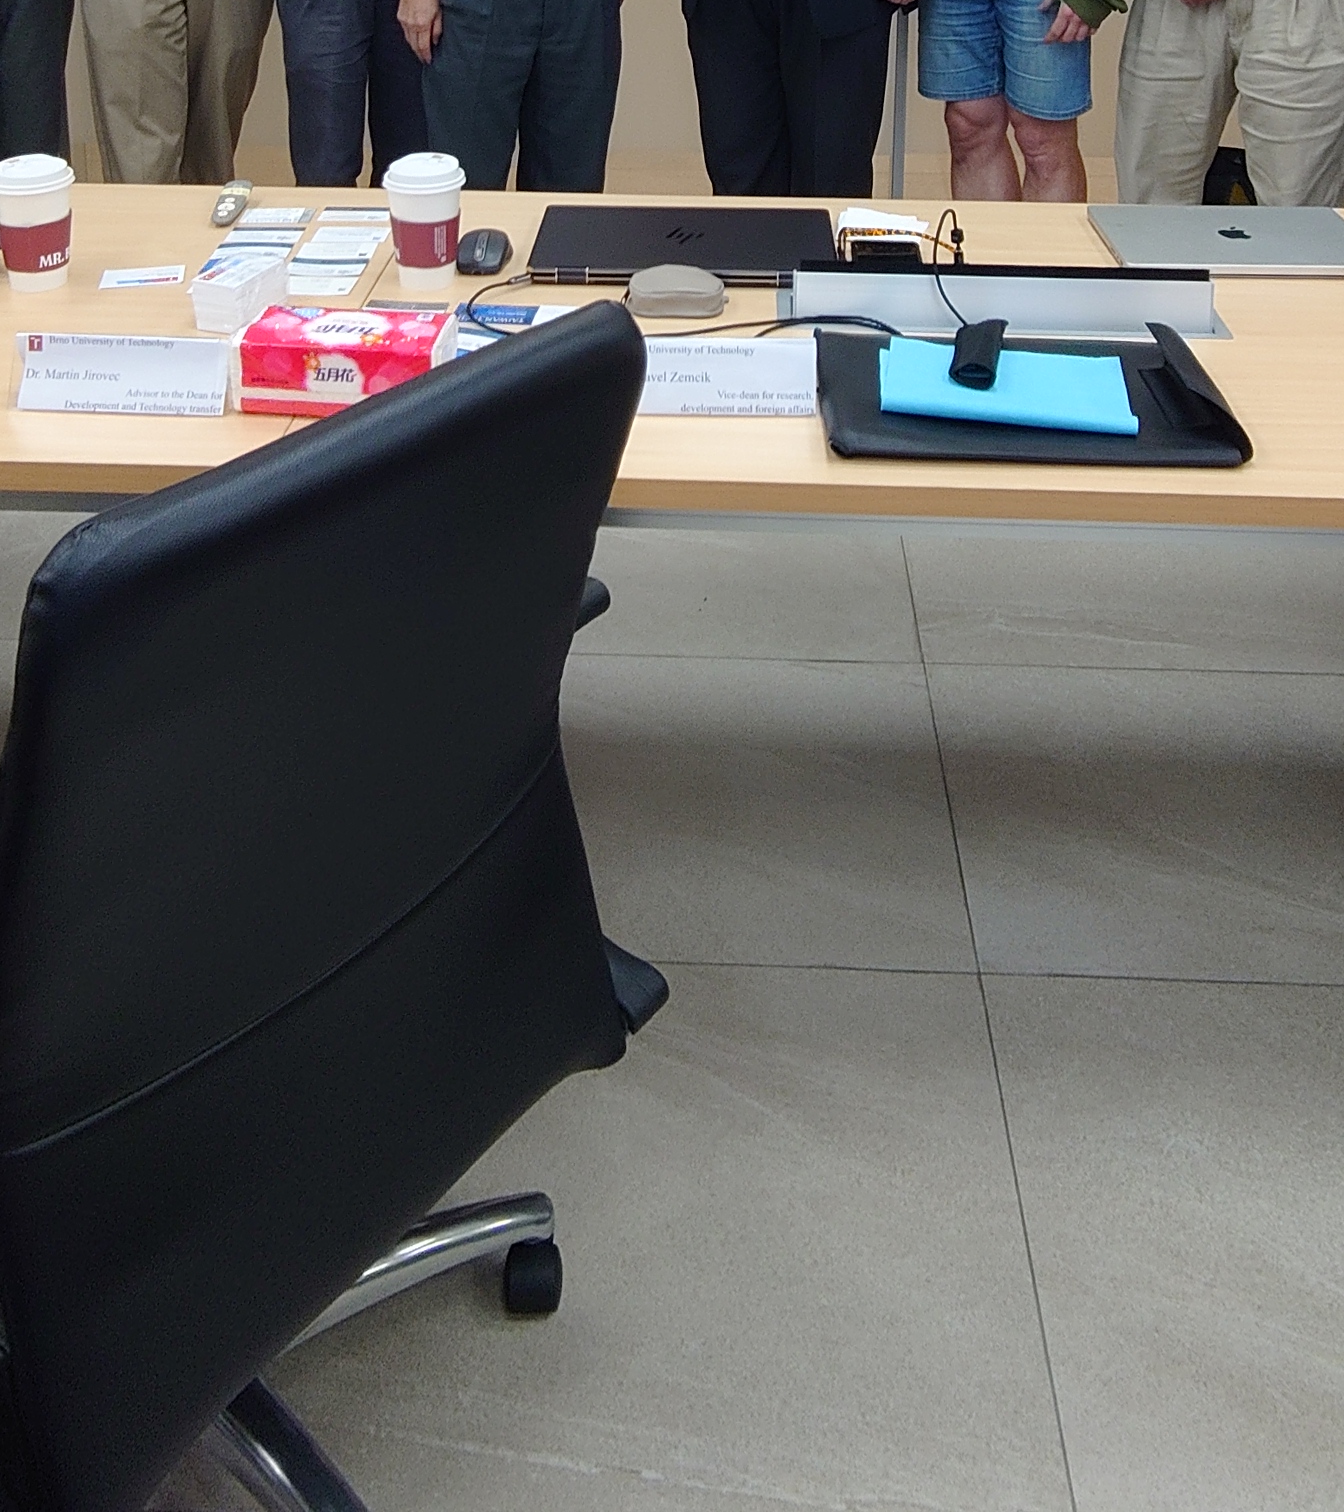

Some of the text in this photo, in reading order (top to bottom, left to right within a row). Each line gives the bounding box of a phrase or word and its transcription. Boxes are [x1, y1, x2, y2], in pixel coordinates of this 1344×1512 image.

[38, 251, 65, 269] MR.
[49, 336, 175, 349] Brno University of Technology
[648, 345, 755, 356] University of Technology
[25, 368, 120, 382] Dr. Martin Jirovec
[313, 367, 358, 383] 五月花
[670, 371, 711, 383] Zemcik
[126, 389, 223, 400] Advisor to the Dean for
[717, 390, 758, 400] Vice-dean
[762, 390, 774, 400] for
[64, 400, 222, 414] Development and Technology transfer
[680, 403, 735, 414] development
[737, 404, 752, 413] and
[755, 404, 785, 415] foreign
